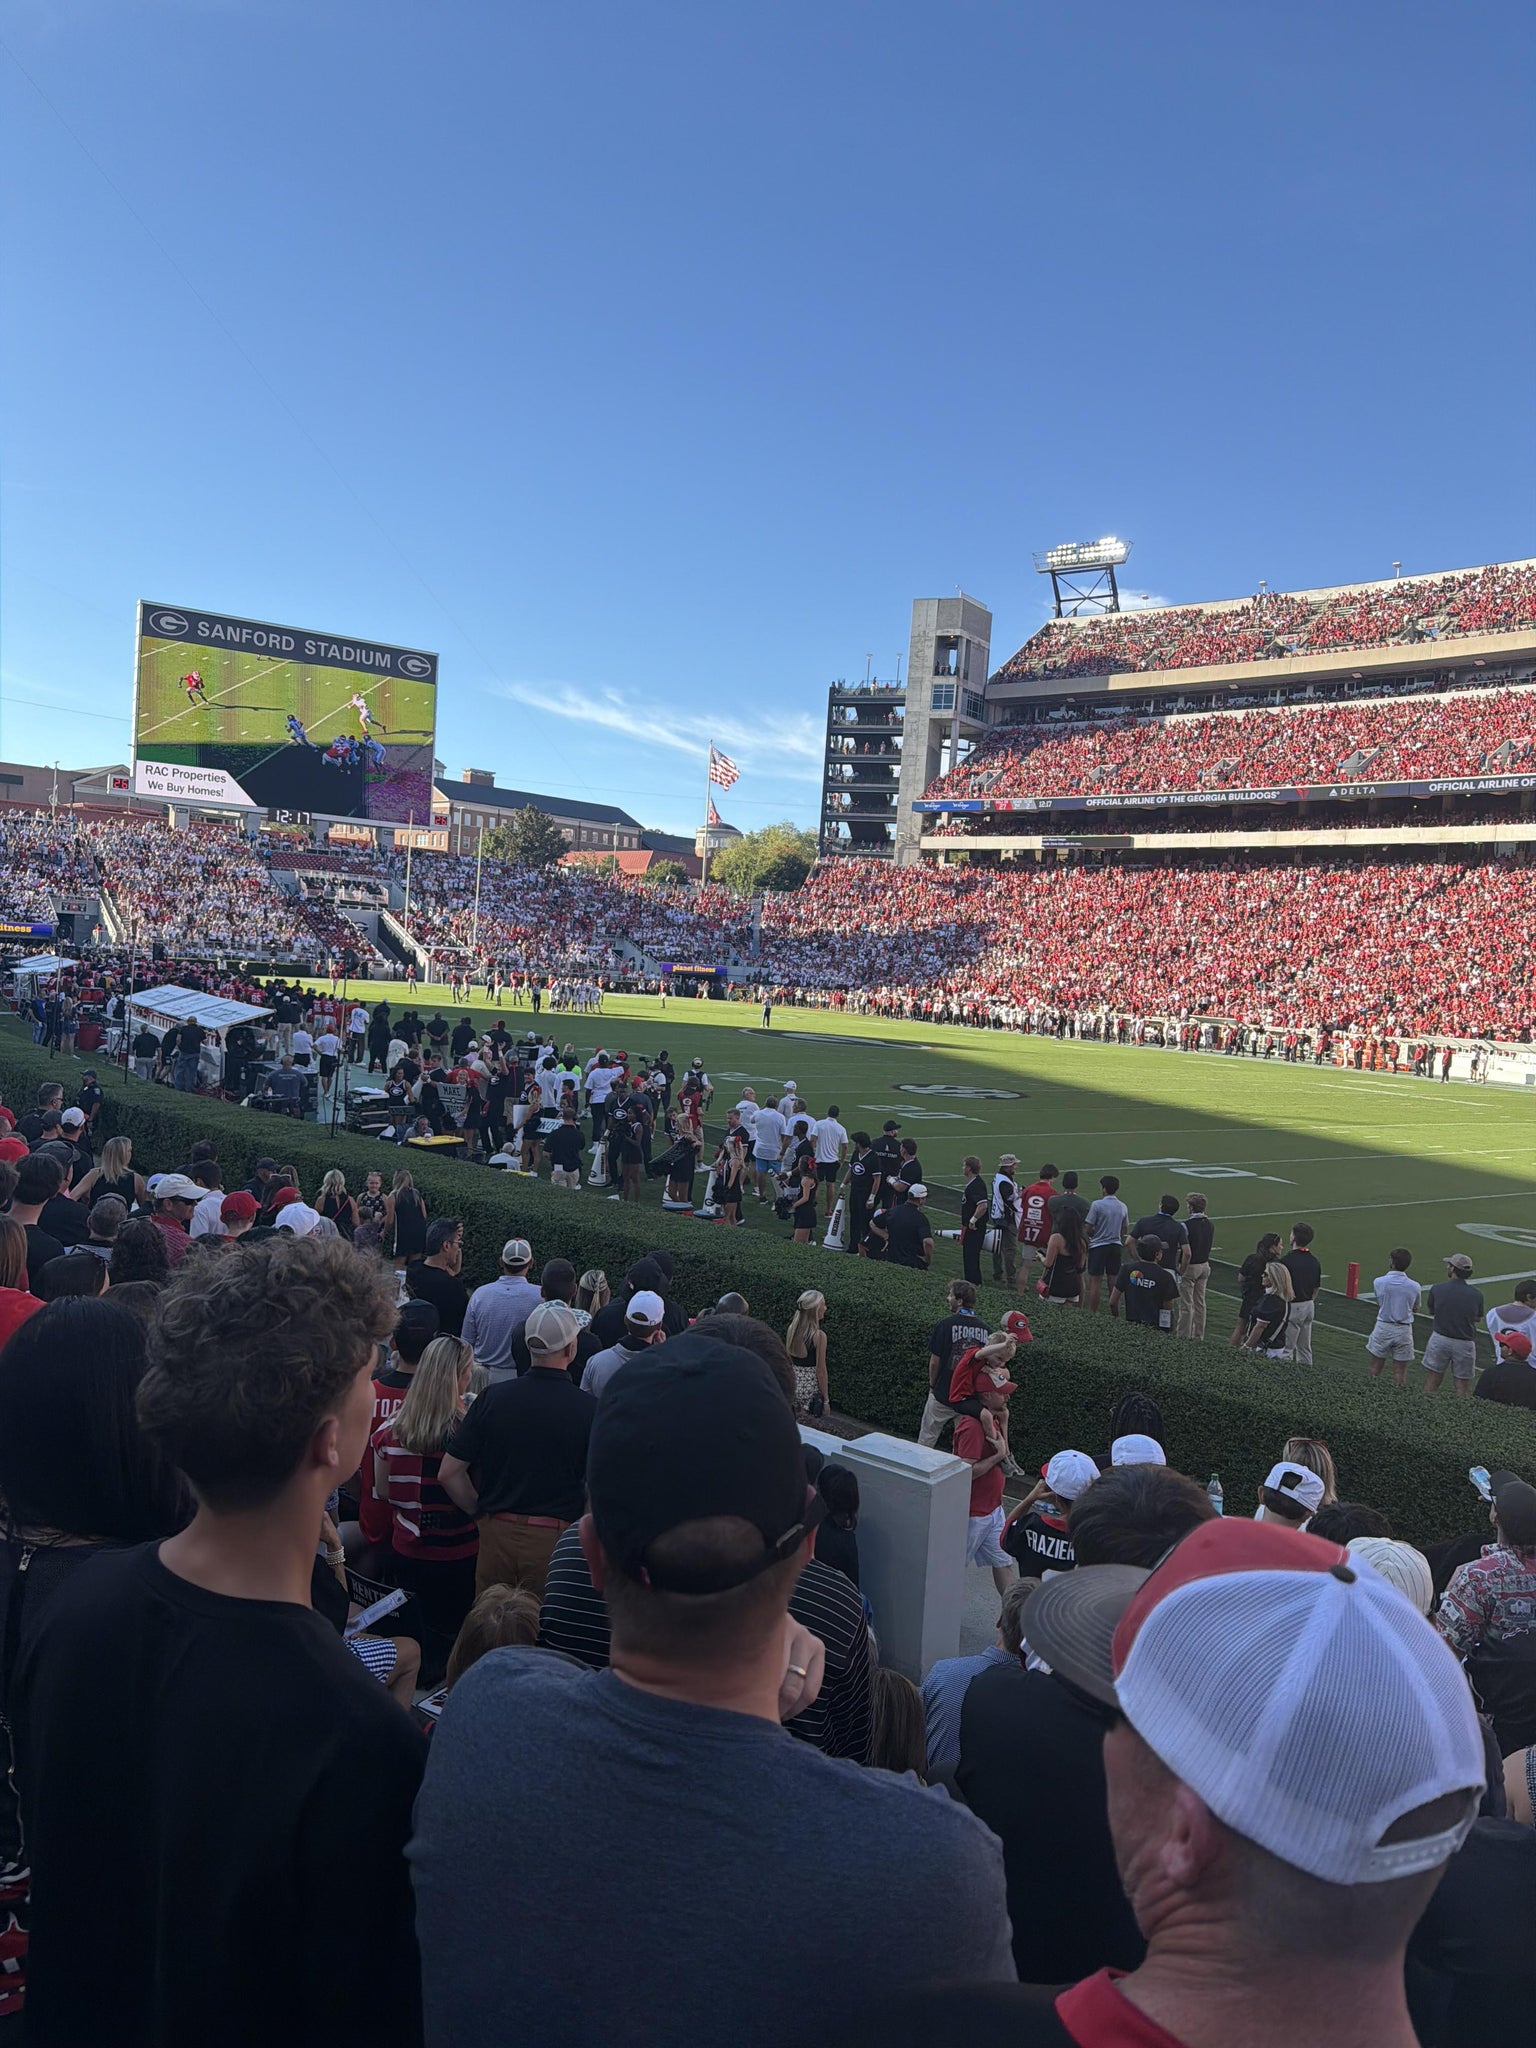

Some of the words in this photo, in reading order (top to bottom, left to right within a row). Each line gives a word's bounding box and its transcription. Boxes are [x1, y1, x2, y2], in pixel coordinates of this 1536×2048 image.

[197, 621, 295, 651] SANFORD
[304, 640, 391, 669] STADIUM
[145, 764, 169, 777] RAC
[172, 768, 227, 784] Properties
[147, 780, 164, 791] We
[166, 782, 185, 795] Buy
[187, 784, 224, 797] Homes!
[1340, 786, 1376, 796] DELTA
[1428, 781, 1475, 792] OFFICIAL
[1477, 778, 1518, 790] AIRLINE
[1520, 777, 1536, 788] OF
[1086, 798, 1122, 806] OFFICIAL
[1123, 796, 1155, 805] AIRLINE
[1156, 795, 1169, 804] OF
[1169, 795, 1186, 803] THE
[1187, 793, 1227, 802] GEORGIA
[276, 809, 310, 825] 12:17
[434, 815, 448, 826] 26
[0, 923, 33, 933] itness
[1024, 1227, 1041, 1242] 17
[1136, 1278, 1156, 1289] NEP
[951, 1324, 990, 1345] GEORGIA
